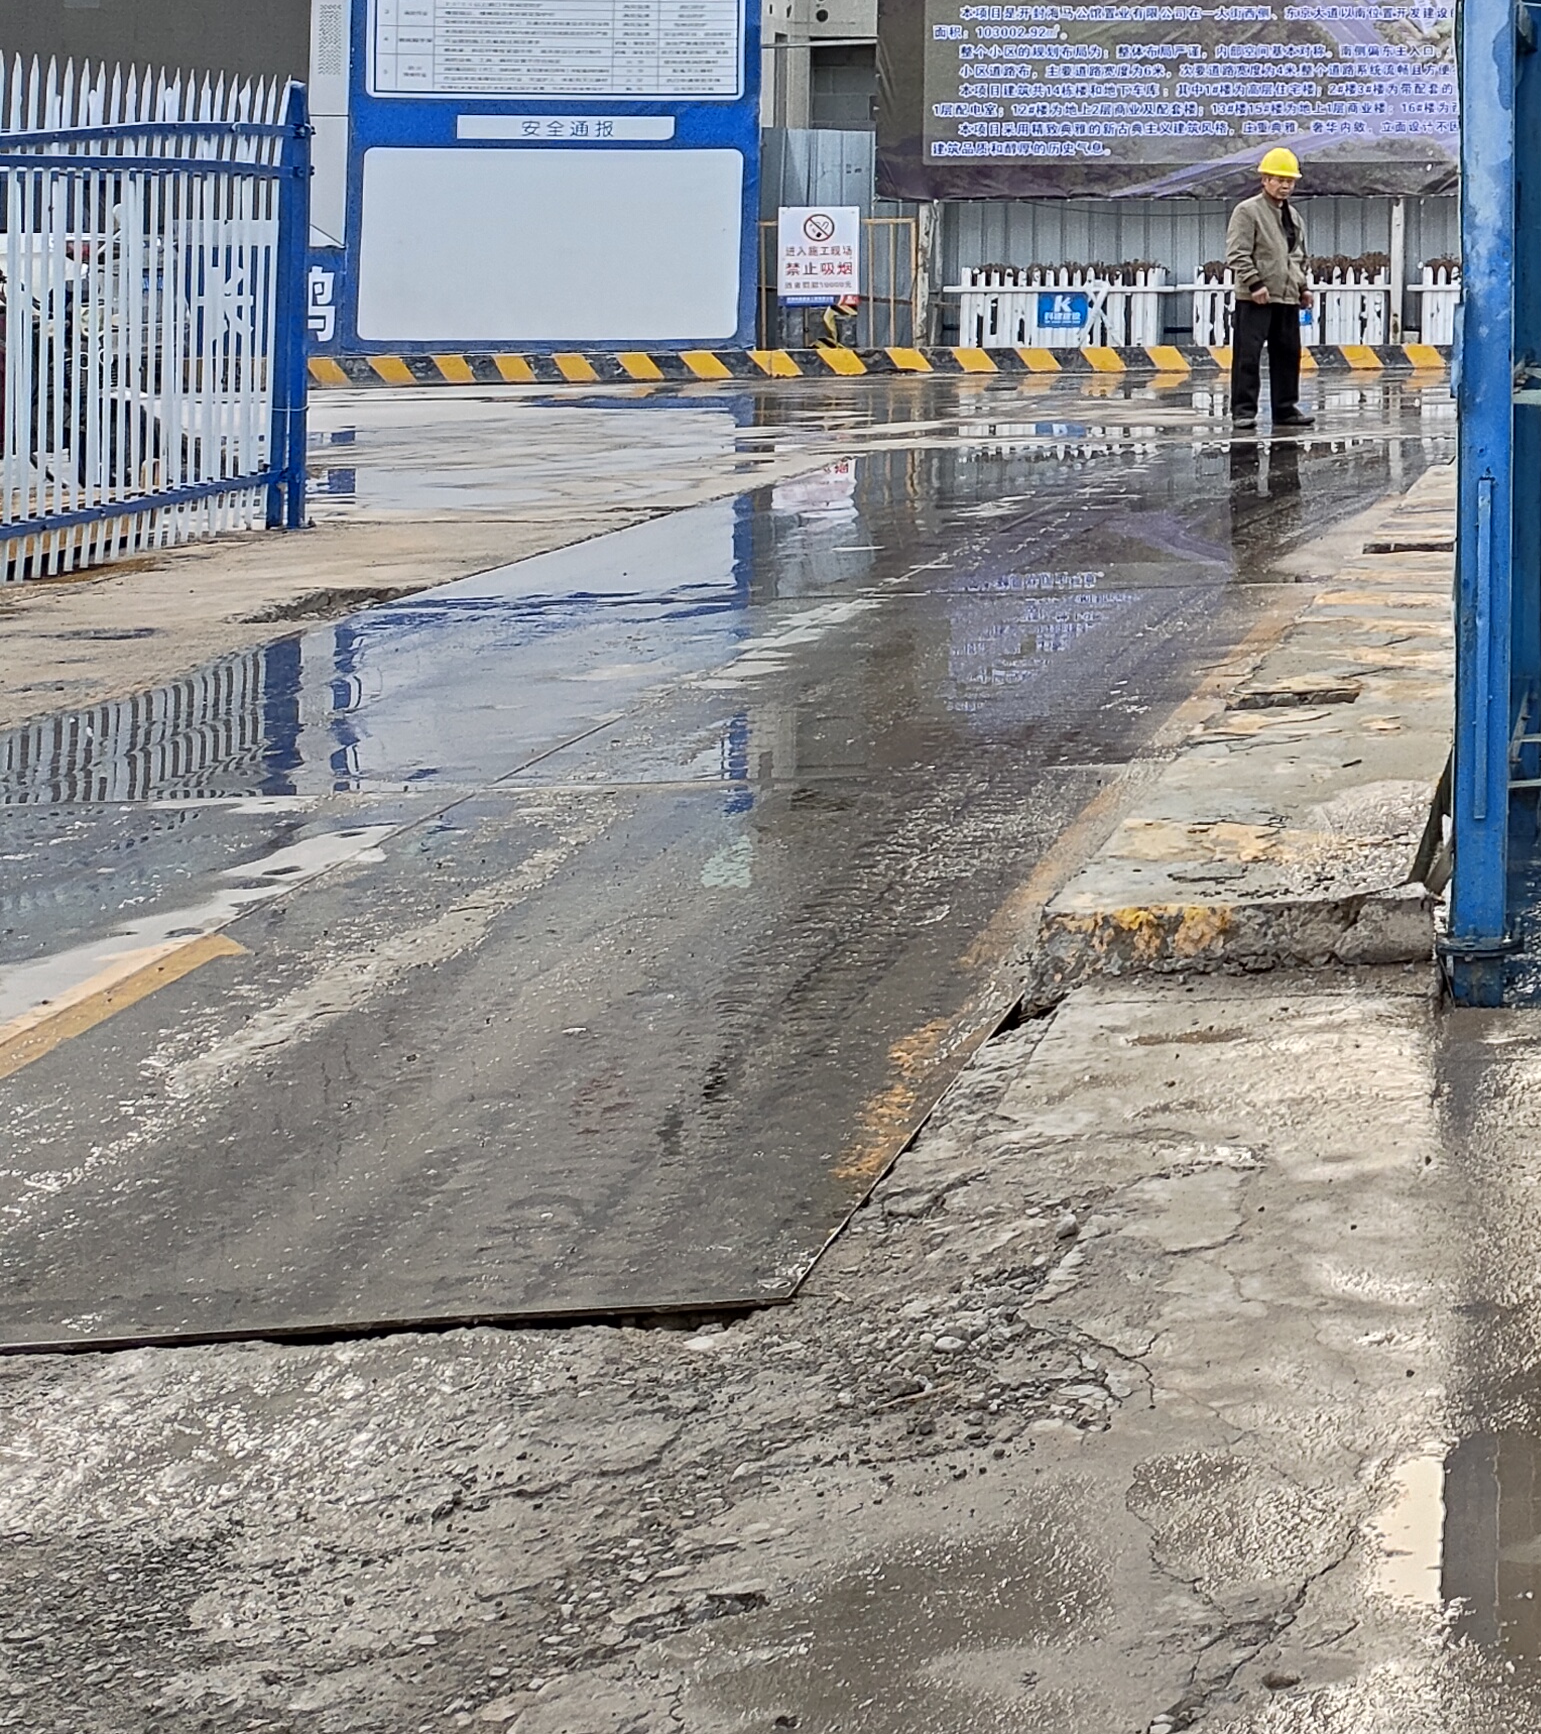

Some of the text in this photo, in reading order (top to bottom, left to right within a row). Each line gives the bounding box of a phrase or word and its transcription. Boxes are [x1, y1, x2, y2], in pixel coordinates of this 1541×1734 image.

[519, 118, 617, 139] 安全通报
[785, 245, 853, 257] 进入施工现场
[785, 261, 853, 276] 禁止吸烟
